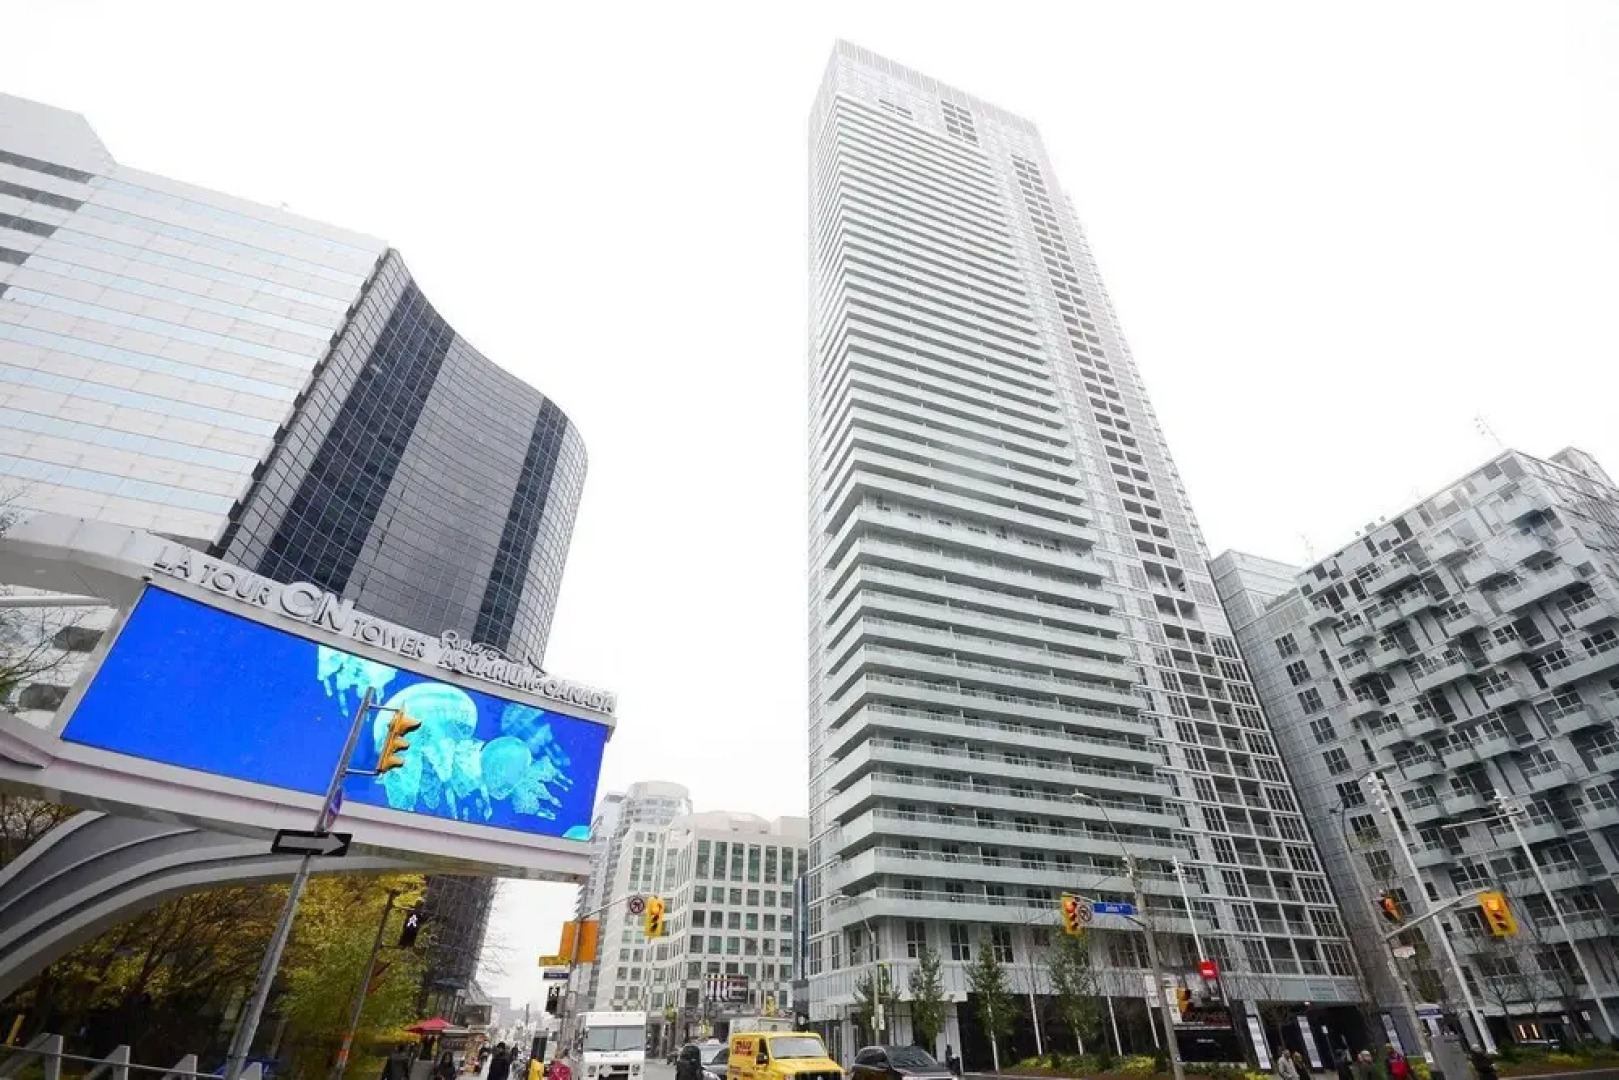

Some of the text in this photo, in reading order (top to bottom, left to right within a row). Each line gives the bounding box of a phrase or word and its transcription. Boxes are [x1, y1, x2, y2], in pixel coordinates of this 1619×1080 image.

[153, 545, 427, 659] LA TOUR CN TOWER
[436, 648, 540, 691] AQUARIUM
[542, 677, 618, 713] CANADA
